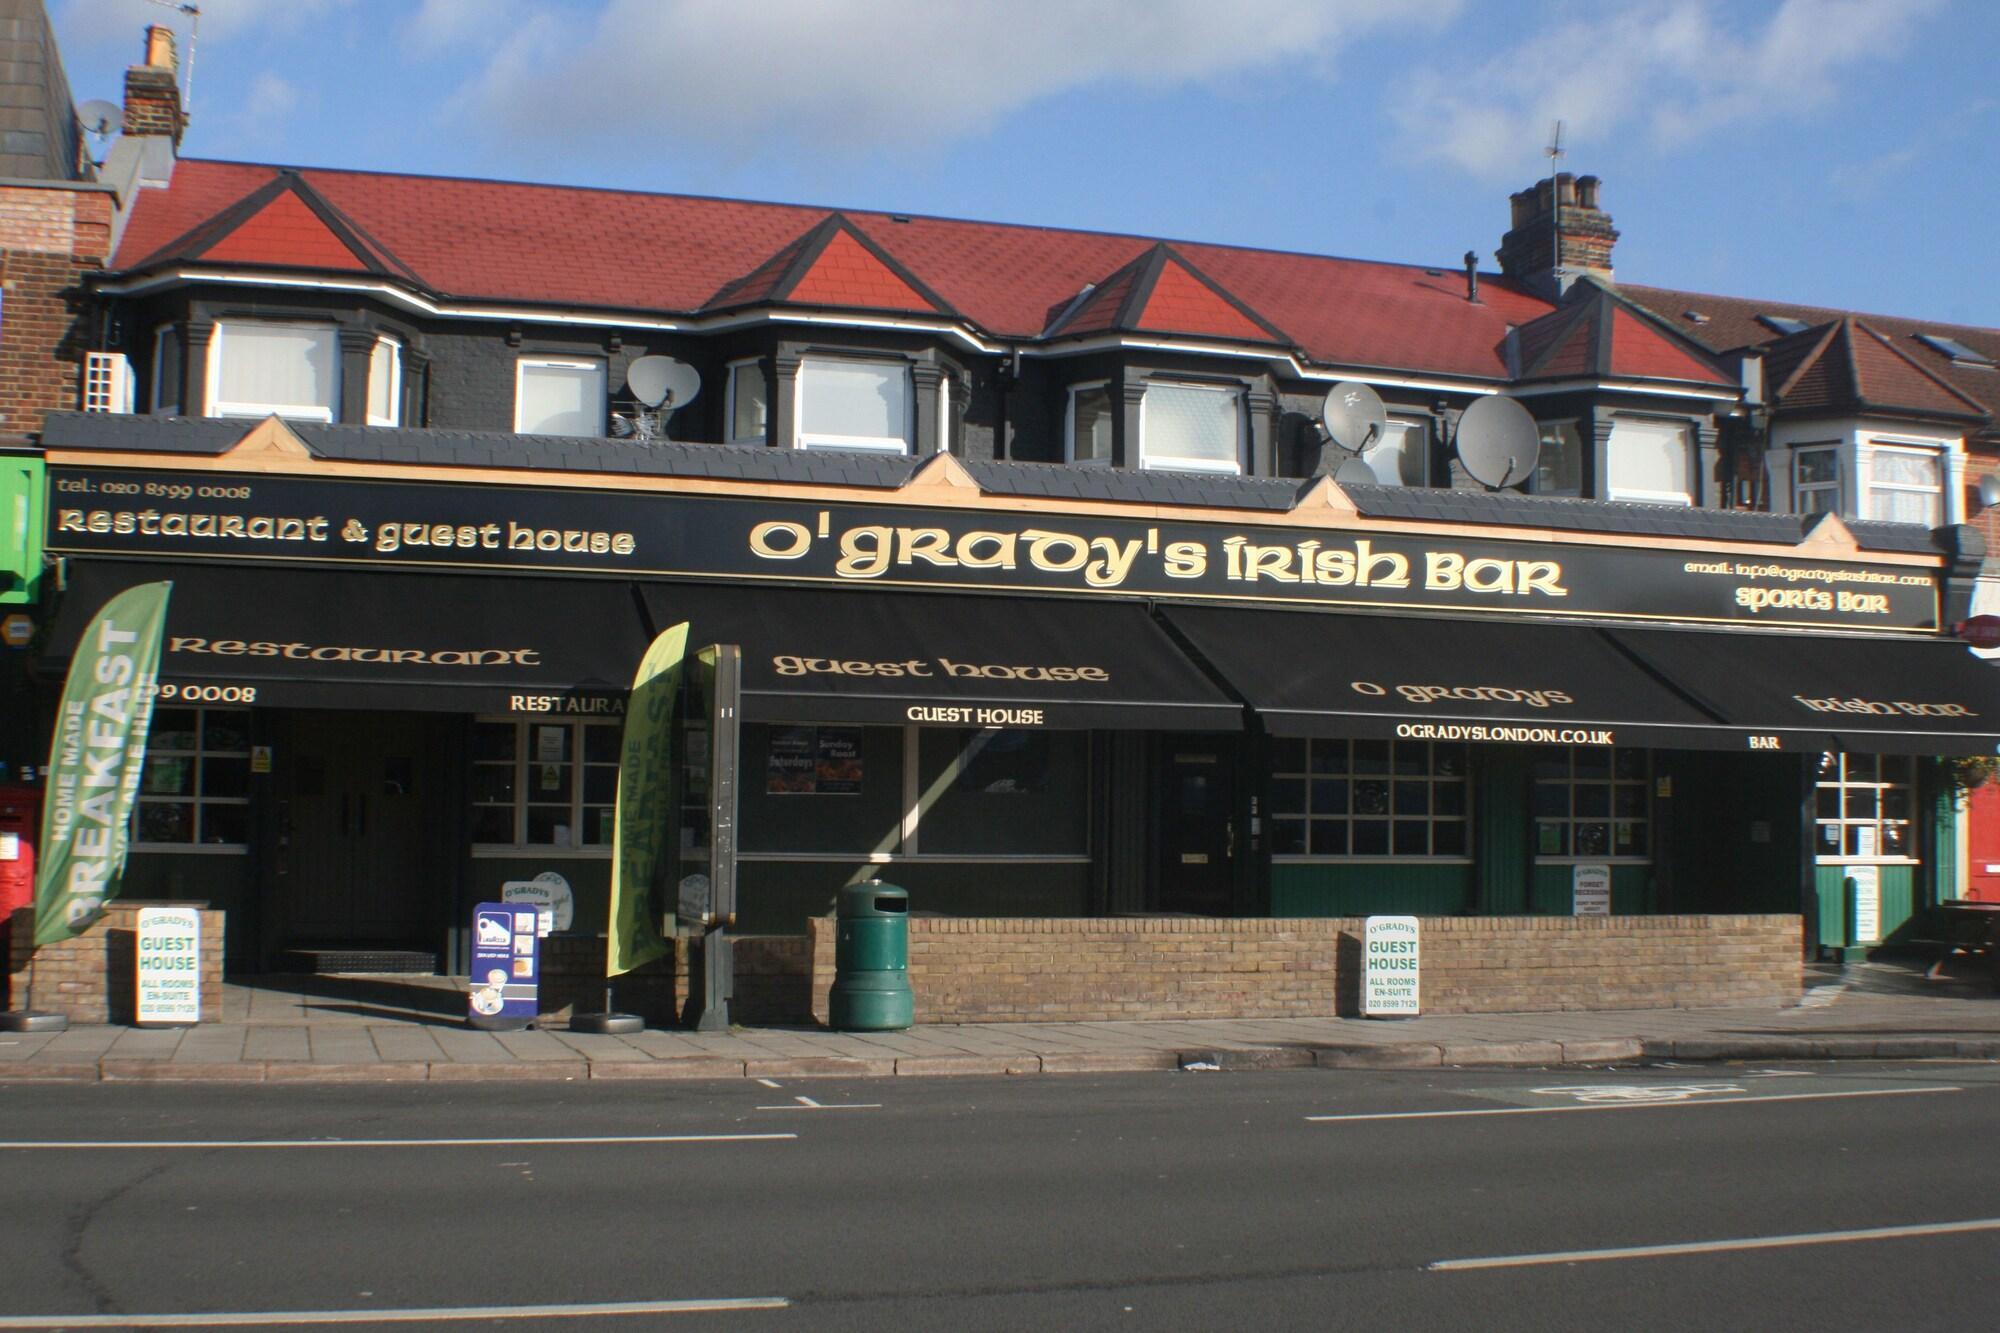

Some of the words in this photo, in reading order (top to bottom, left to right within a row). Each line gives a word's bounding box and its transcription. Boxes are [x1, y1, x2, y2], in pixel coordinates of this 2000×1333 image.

[102, 482, 140, 495] 020
[145, 483, 193, 500] 8599
[198, 486, 251, 499] 0008
[341, 517, 369, 542] &
[376, 522, 501, 552] guest
[508, 521, 636, 554] house
[181, 685, 256, 703] 0008
[511, 695, 625, 713] RESTAURA
[907, 706, 972, 723] GUEST
[976, 708, 1043, 725] HOUSE
[62, 700, 86, 766] MADE
[1396, 723, 1614, 745] OGRADYSLONDON.CO.UK
[1748, 735, 1781, 749] BAR
[67, 619, 138, 931] BREAKFAST
[51, 773, 77, 842] HOME
[1369, 922, 1416, 934] O'GRADYS
[140, 937, 195, 951] GUEST
[1369, 941, 1417, 953] GUEST
[140, 956, 196, 970] HOUSE
[1368, 958, 1417, 970] HOUSE
[141, 979, 160, 988] ALL
[1369, 978, 1385, 986] ALL
[1386, 978, 1416, 986] ROOMS
[1374, 987, 1412, 996] EN-SUITE
